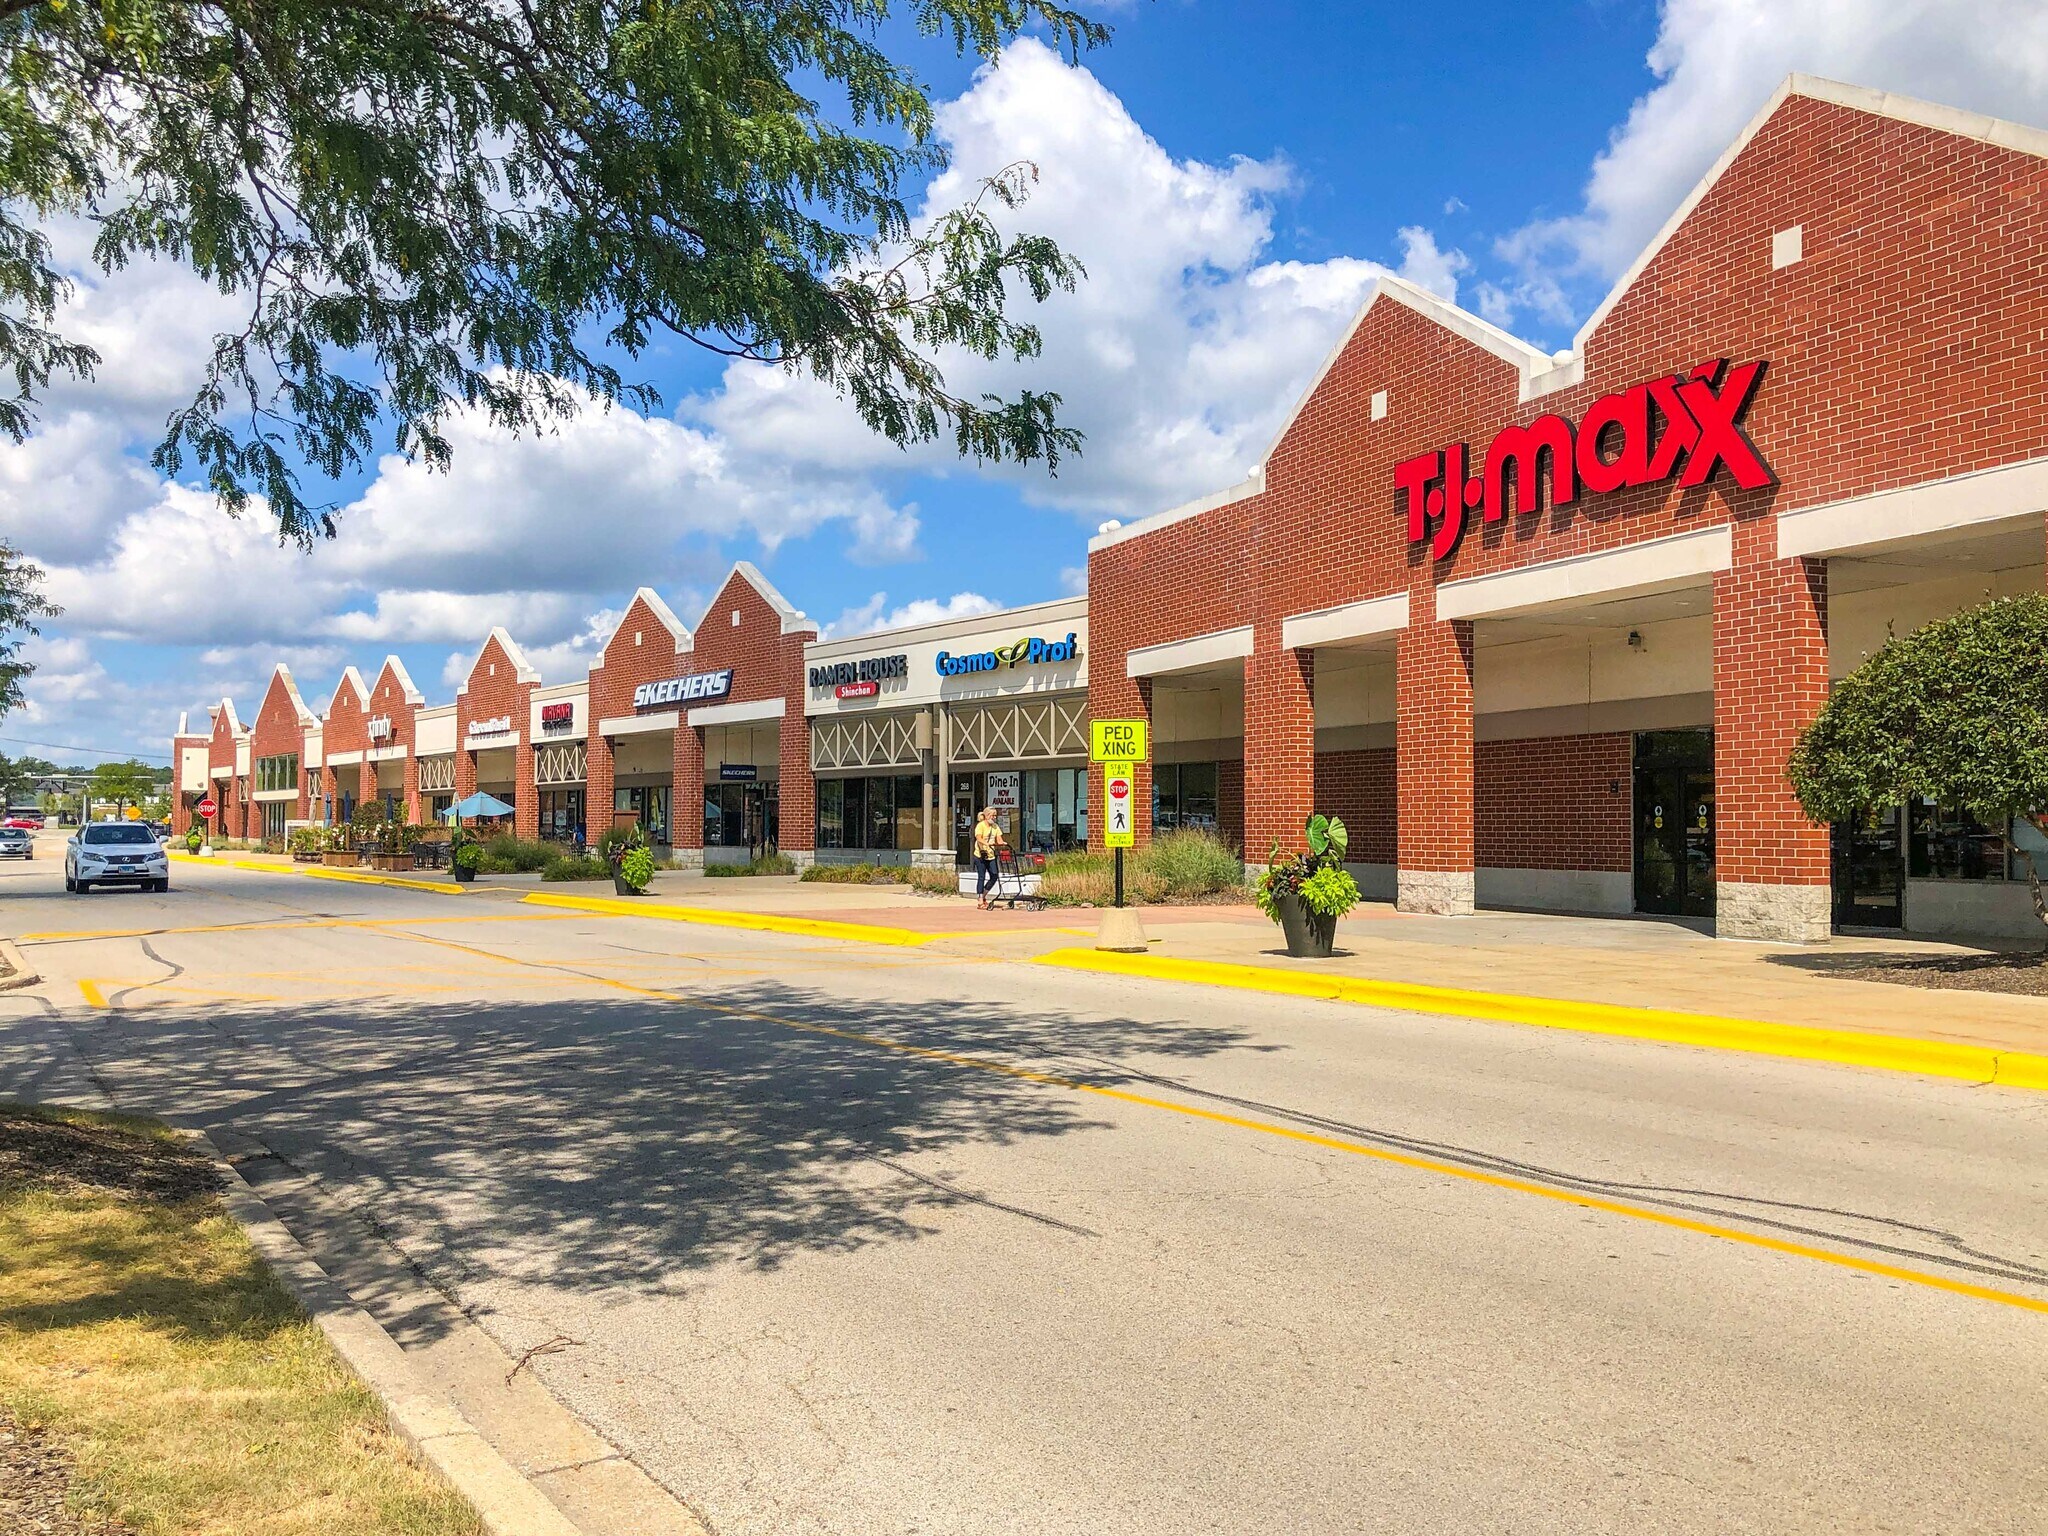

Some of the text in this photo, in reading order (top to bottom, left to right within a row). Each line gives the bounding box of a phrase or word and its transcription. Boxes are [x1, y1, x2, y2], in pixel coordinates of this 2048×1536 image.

[936, 633, 1076, 676] Cosmo Prof
[809, 655, 907, 687] RAMEN HOUSE
[633, 671, 729, 707] SKECHERS
[841, 686, 871, 698] Shinchan
[541, 703, 571, 721] NIRVANA
[367, 713, 392, 742] xfinity
[1104, 726, 1133, 740] PED
[1103, 741, 1136, 755] XING
[989, 775, 1019, 788] Dine In
[997, 789, 1010, 797] NOW
[1110, 785, 1128, 794] STOP
[992, 797, 1015, 805] AVAILABLE
[200, 805, 216, 813] STOP
